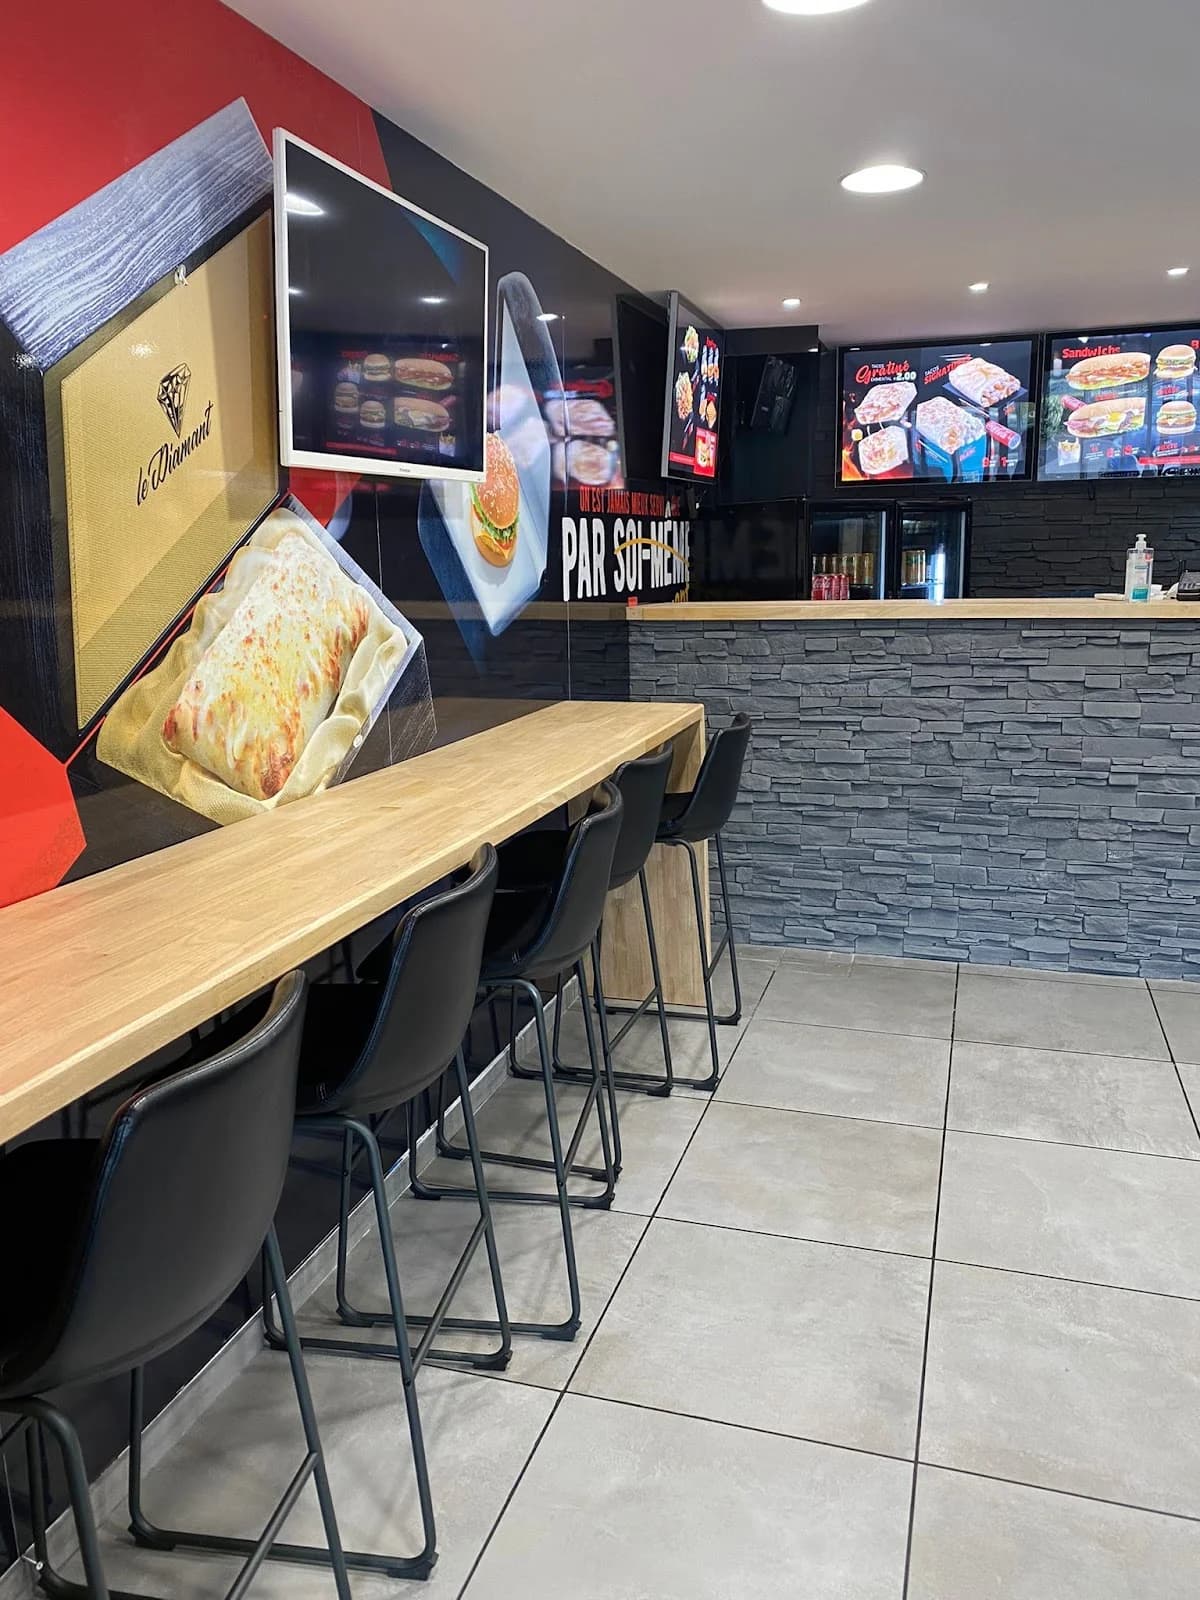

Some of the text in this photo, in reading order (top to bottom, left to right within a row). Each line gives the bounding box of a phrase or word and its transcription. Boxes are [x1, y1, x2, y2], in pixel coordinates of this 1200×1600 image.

[855, 360, 910, 384] Gratiné
[137, 400, 213, 506] le Diamant
[579, 486, 590, 512] ON
[591, 487, 605, 513] EST
[561, 517, 607, 602] PAR
